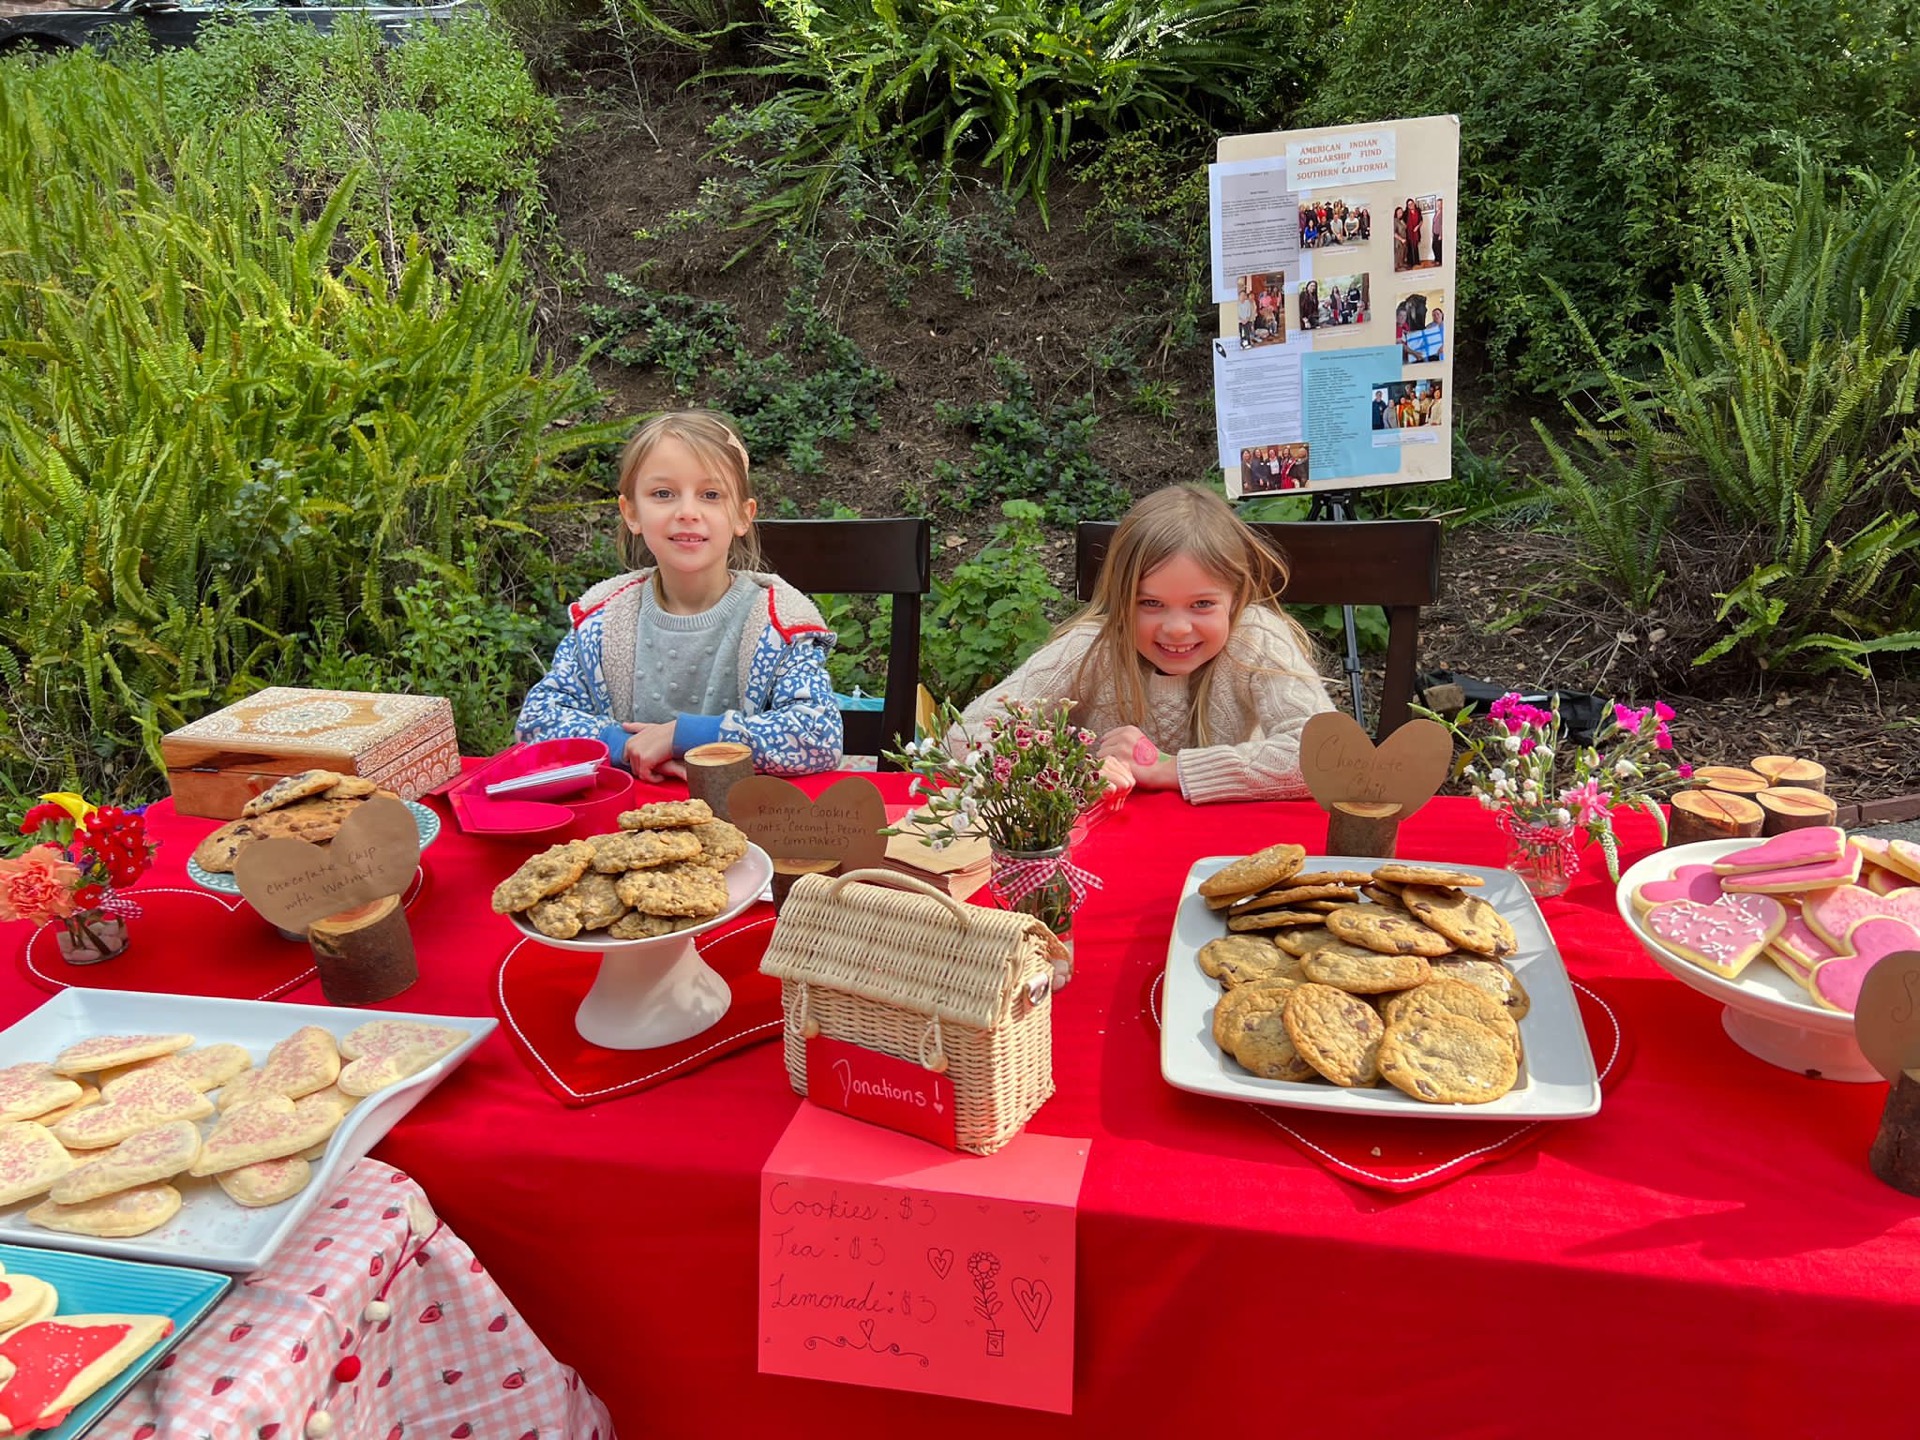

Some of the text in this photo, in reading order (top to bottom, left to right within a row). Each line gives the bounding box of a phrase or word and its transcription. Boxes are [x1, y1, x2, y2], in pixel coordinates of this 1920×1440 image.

[1298, 152, 1352, 166] SCHOLARSHIP
[1360, 149, 1382, 158] FUND
[1300, 138, 1378, 155] AMERICAN INDIAN
[1297, 168, 1338, 180] SOUTHERN
[1342, 162, 1388, 174] CALIFORNIA
[1315, 734, 1403, 773] Chocolate
[1346, 773, 1387, 799] Chip
[758, 804, 861, 821] Ranger Cookies
[899, 1195, 938, 1227] $3
[850, 1236, 886, 1267] $3
[901, 1290, 938, 1325] $3
